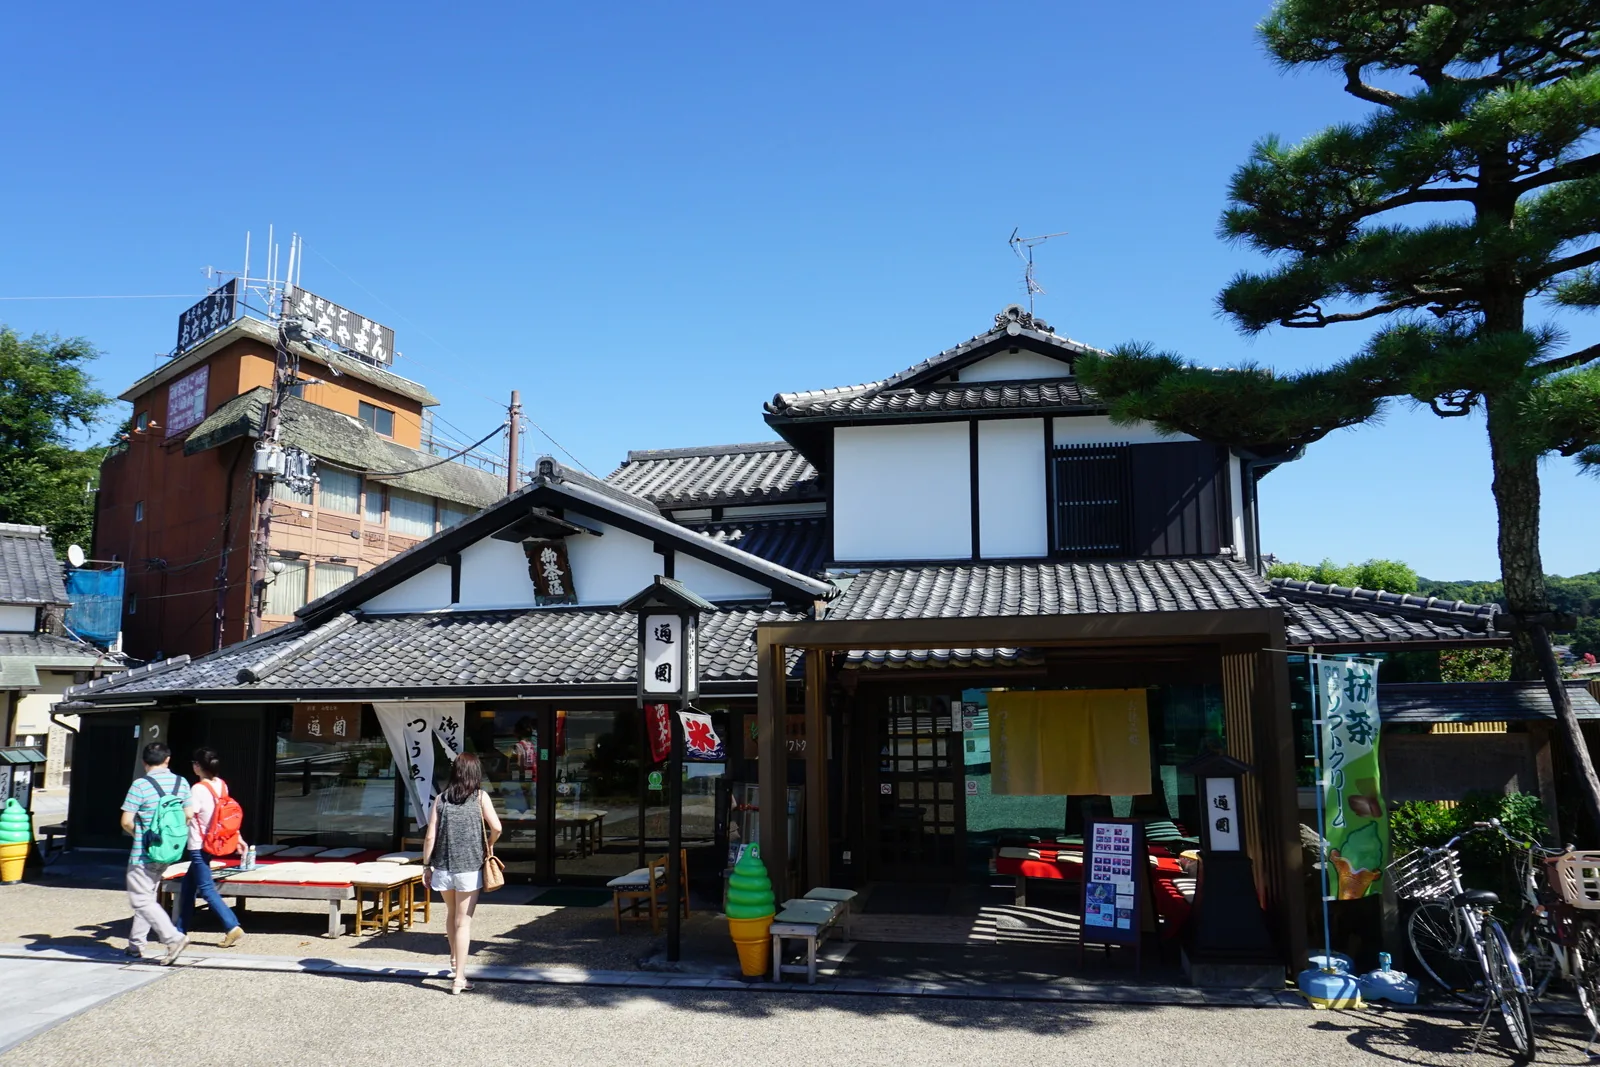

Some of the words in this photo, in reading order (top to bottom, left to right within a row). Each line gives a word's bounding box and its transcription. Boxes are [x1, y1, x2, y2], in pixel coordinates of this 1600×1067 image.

[1343, 668, 1375, 746] 抹茶
[1326, 695, 1346, 828] ソフトクリーム
